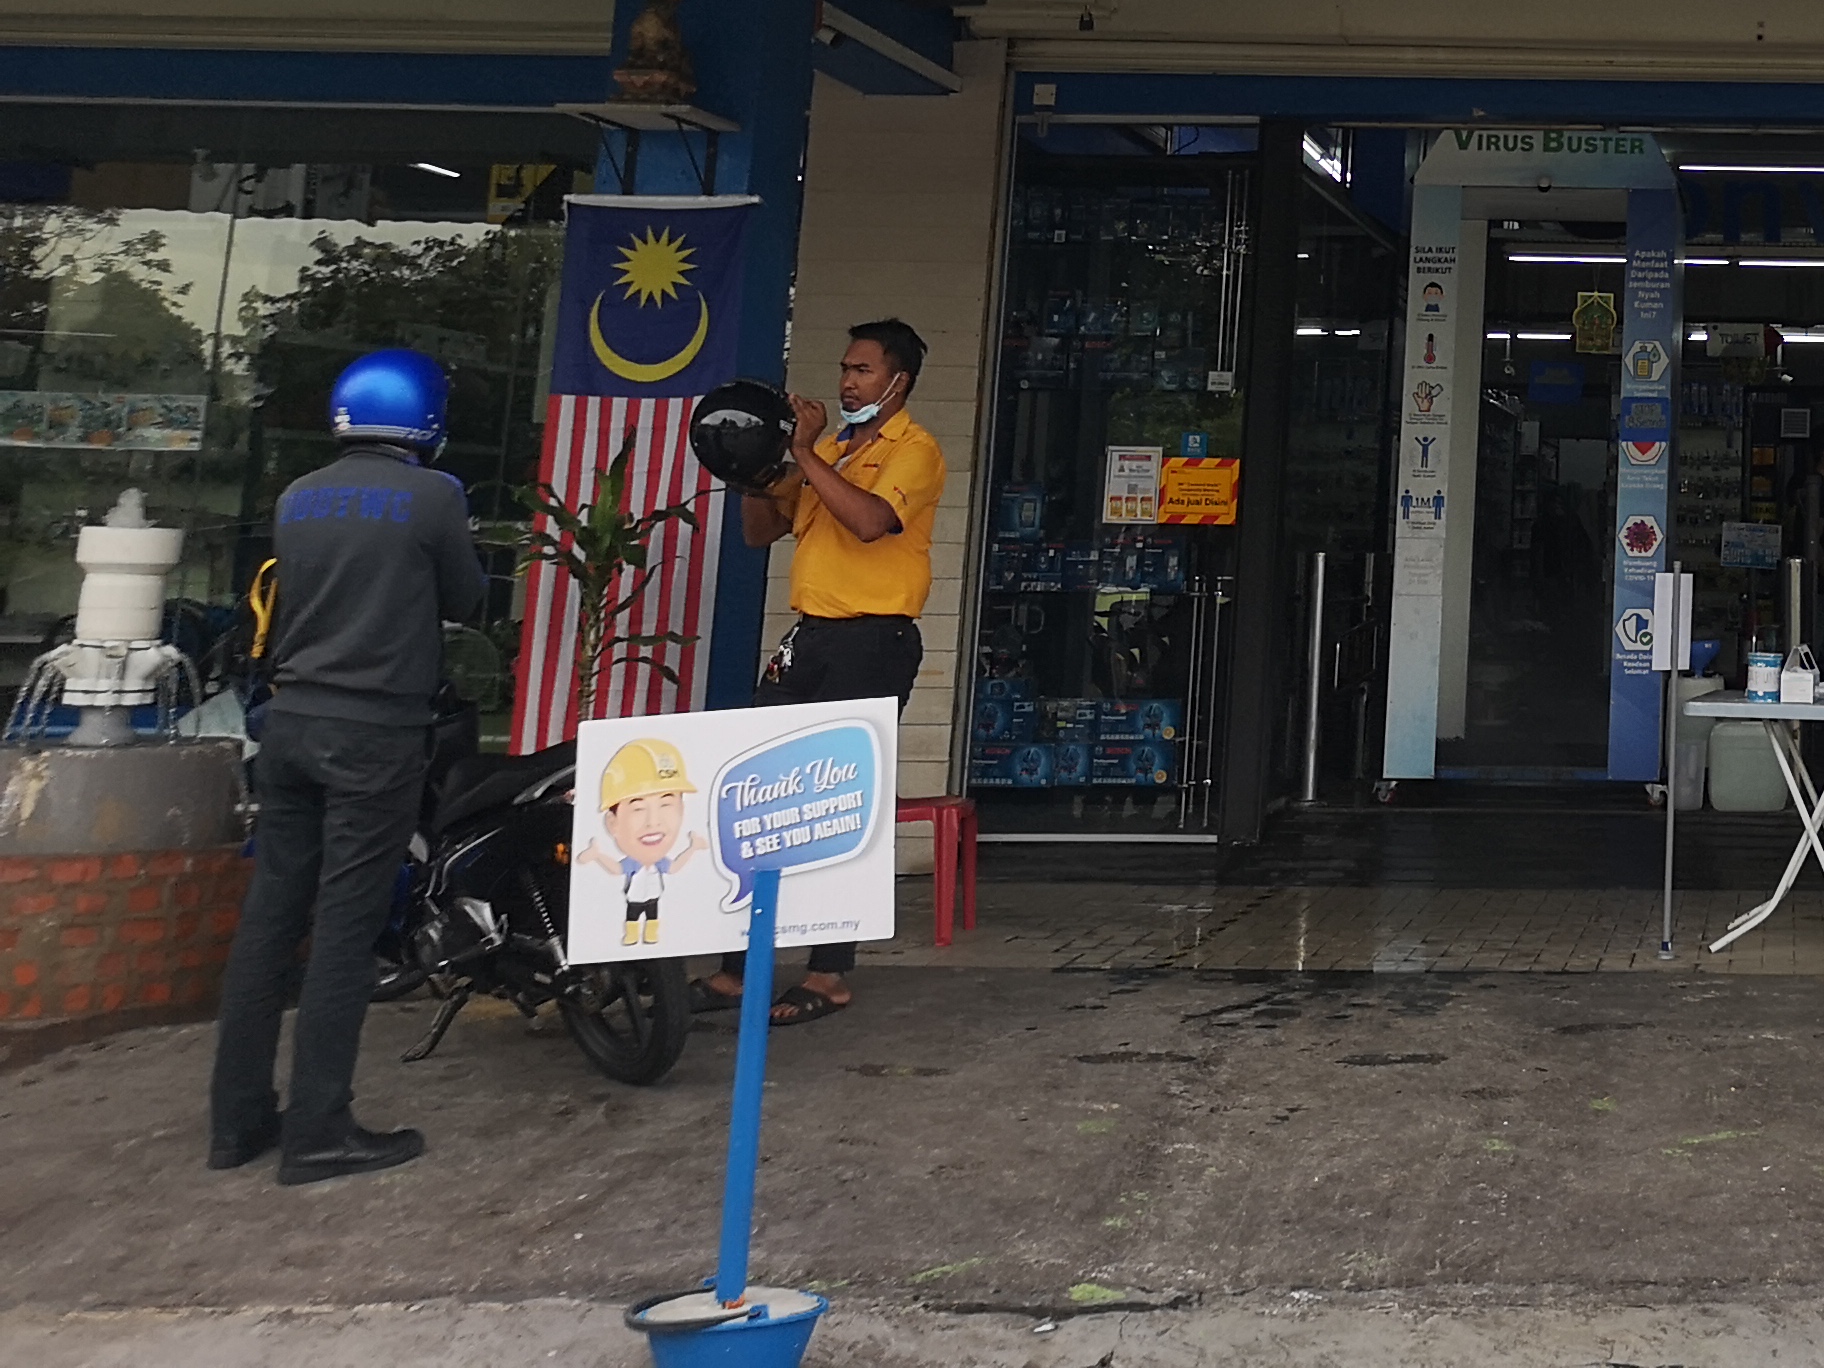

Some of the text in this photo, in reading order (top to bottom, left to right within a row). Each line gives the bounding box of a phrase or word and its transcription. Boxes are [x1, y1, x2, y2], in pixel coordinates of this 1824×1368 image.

[1453, 129, 1645, 155] VIRUS BUSTER
[1414, 245, 1456, 254] SILA IKUT
[1634, 249, 1667, 259] Apakah
[1413, 255, 1456, 265] LANGKAH
[1416, 265, 1453, 275] BERIKUT
[1630, 270, 1670, 280] Daripada
[658, 768, 681, 779] CSM
[720, 757, 858, 812] Thank You
[733, 790, 864, 839] FOR YOUR SUPPORT
[740, 813, 862, 859] & SEE YOU AGAIN!
